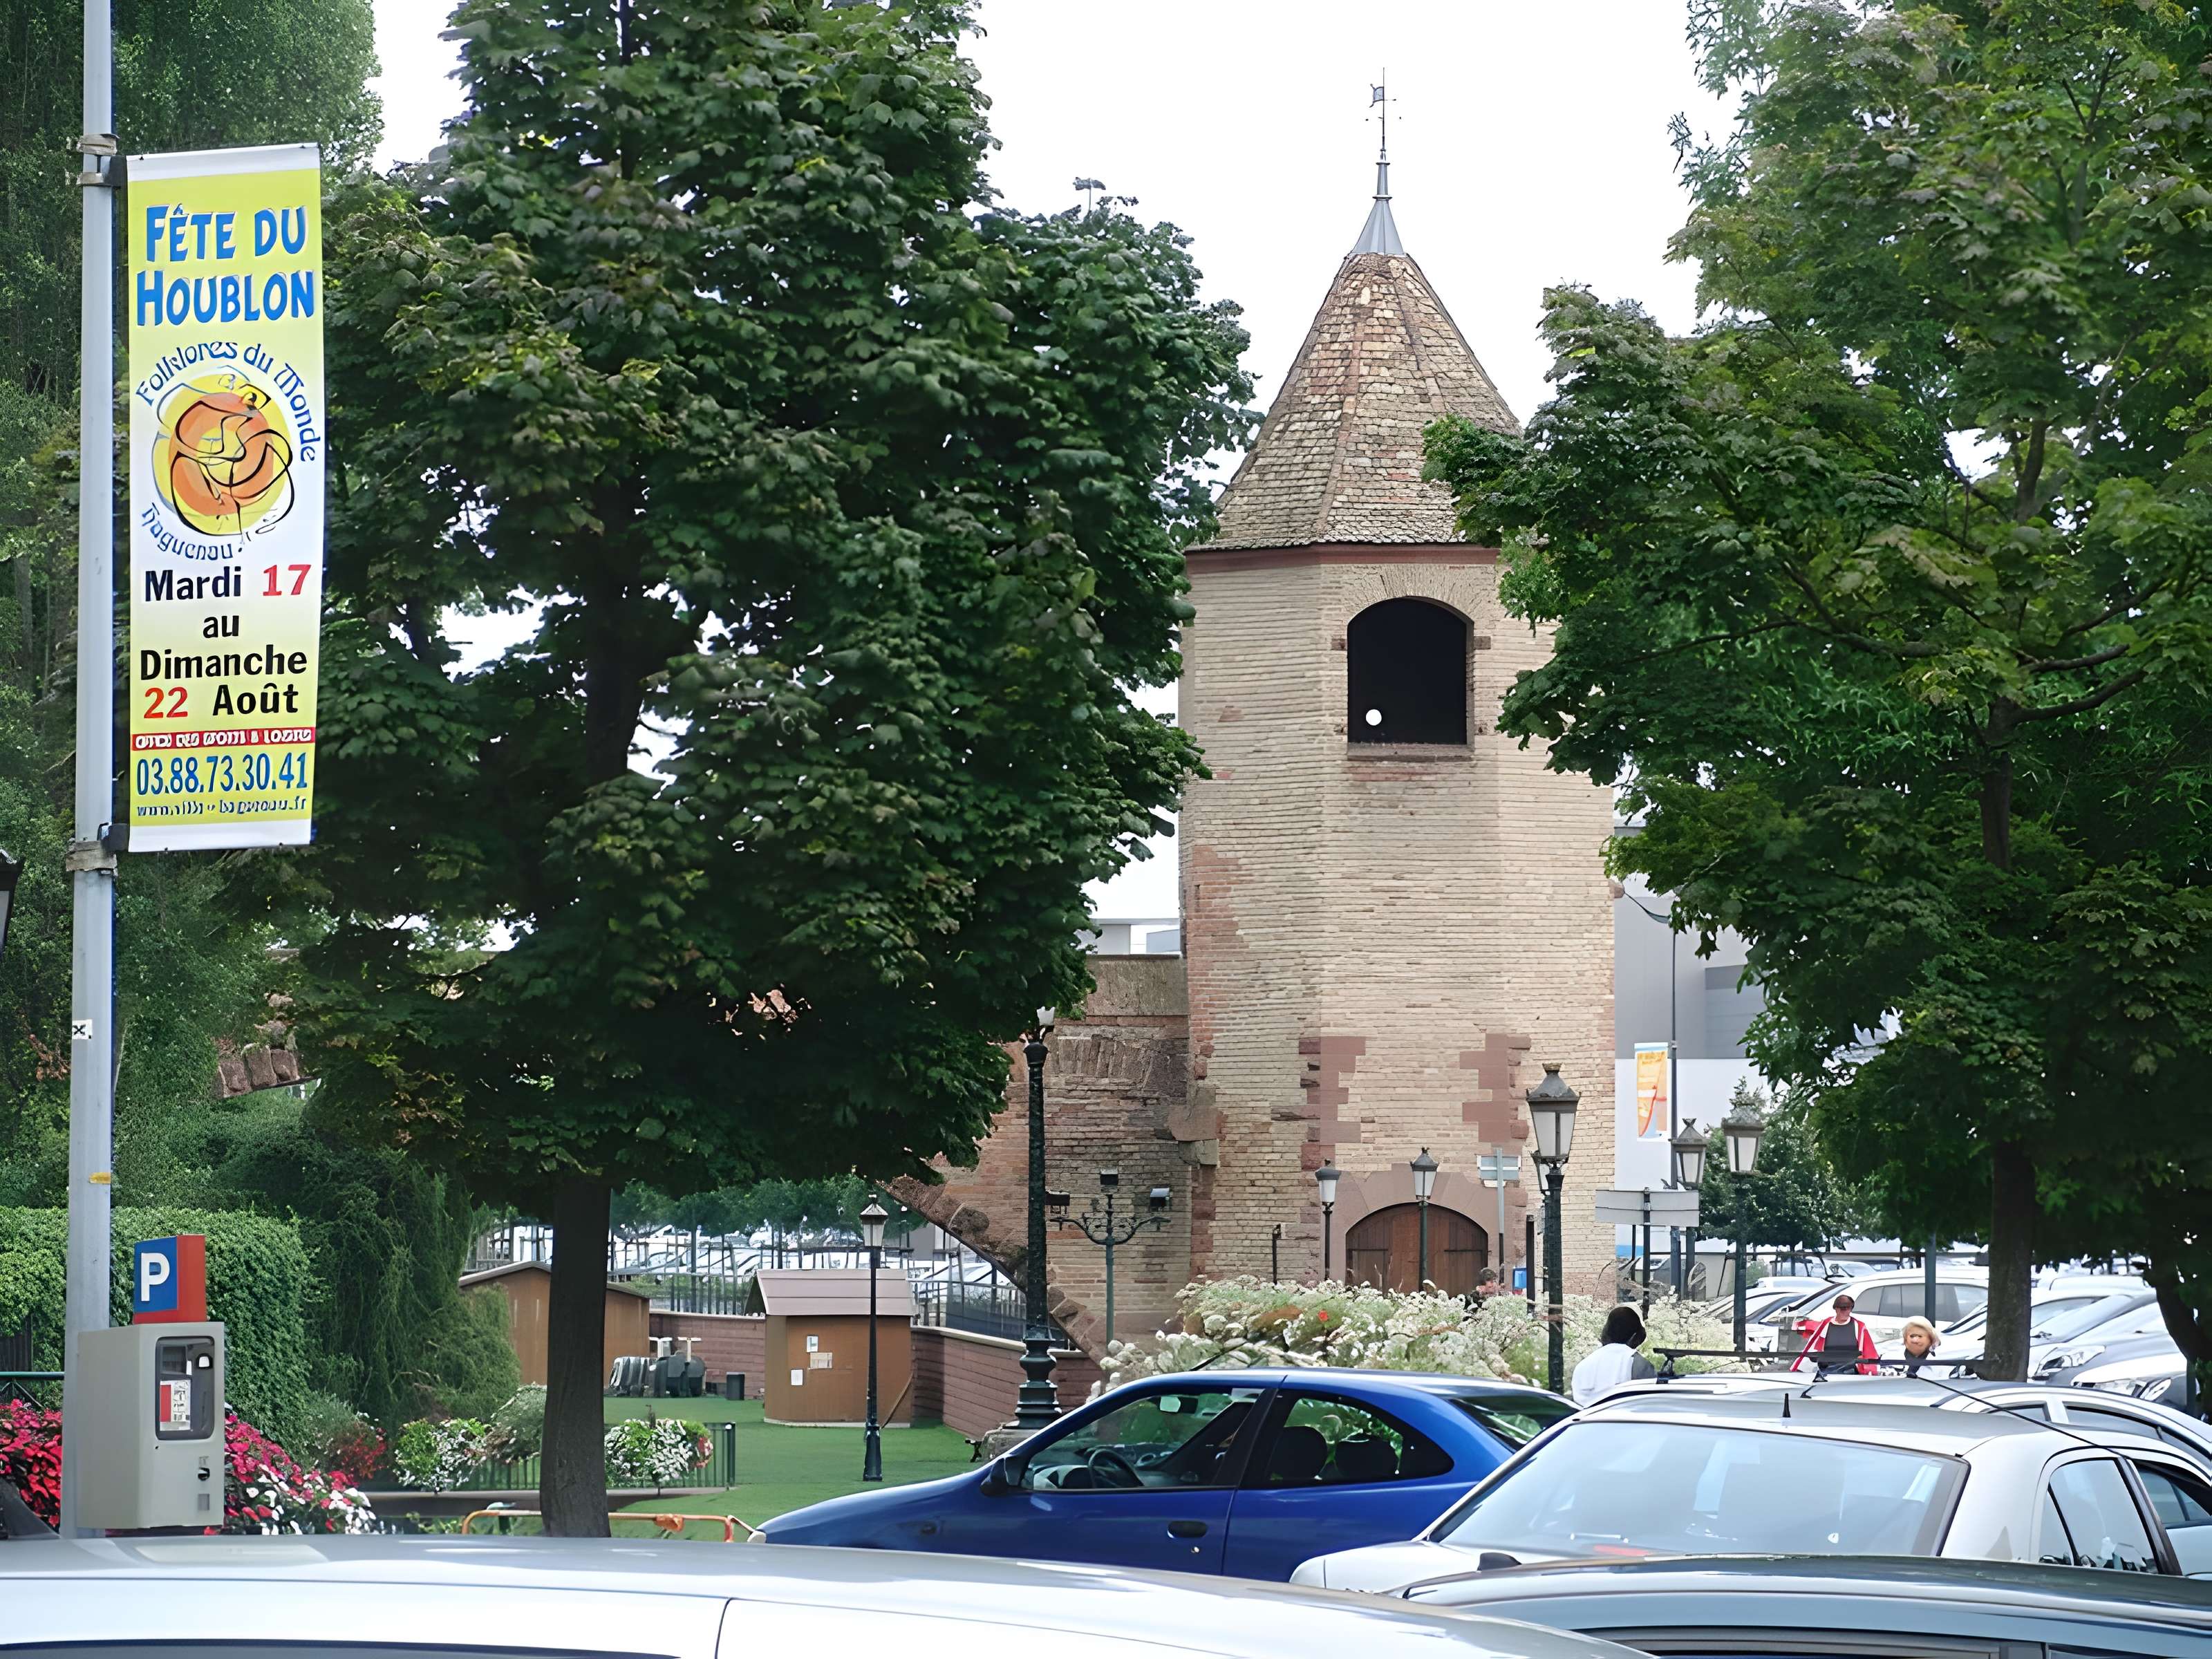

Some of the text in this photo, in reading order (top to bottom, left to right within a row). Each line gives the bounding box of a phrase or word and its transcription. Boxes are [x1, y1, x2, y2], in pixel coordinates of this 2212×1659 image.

[146, 204, 306, 262] FÊTE DU
[136, 270, 315, 326] HOUBLON
[135, 341, 321, 462] Folklores du Monde
[144, 564, 311, 602] Mardi 17
[203, 615, 240, 638] au
[140, 644, 308, 680] Dimanche
[143, 682, 299, 719] 22 Août
[137, 751, 308, 796] 03.88.73.30.41
[141, 1253, 170, 1302] P
